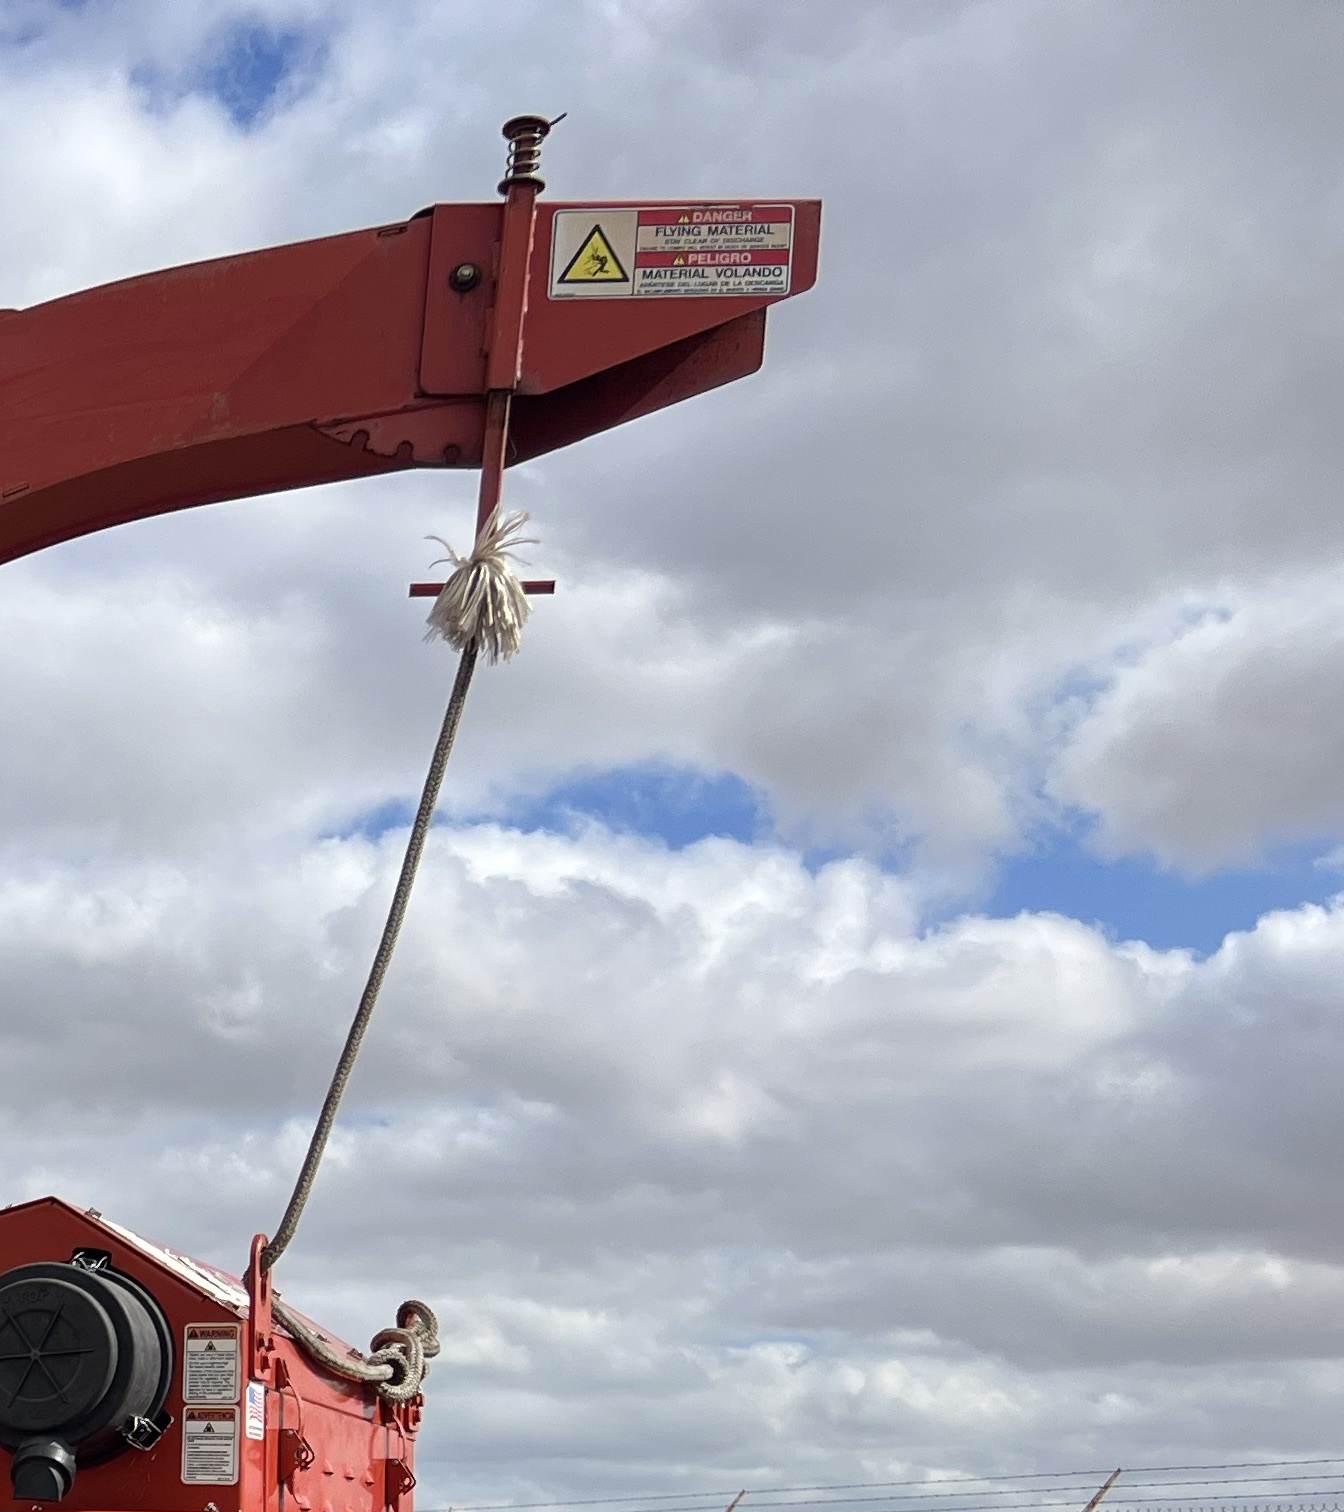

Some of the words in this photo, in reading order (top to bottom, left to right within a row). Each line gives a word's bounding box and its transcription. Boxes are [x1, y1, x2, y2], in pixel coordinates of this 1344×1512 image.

[693, 211, 752, 222] DANGER
[656, 226, 700, 236] FLYING
[708, 225, 774, 235] MATERIAL
[688, 253, 751, 264] PELIGRO
[642, 269, 708, 279] MATERIAL
[716, 267, 782, 278] VOLANDO
